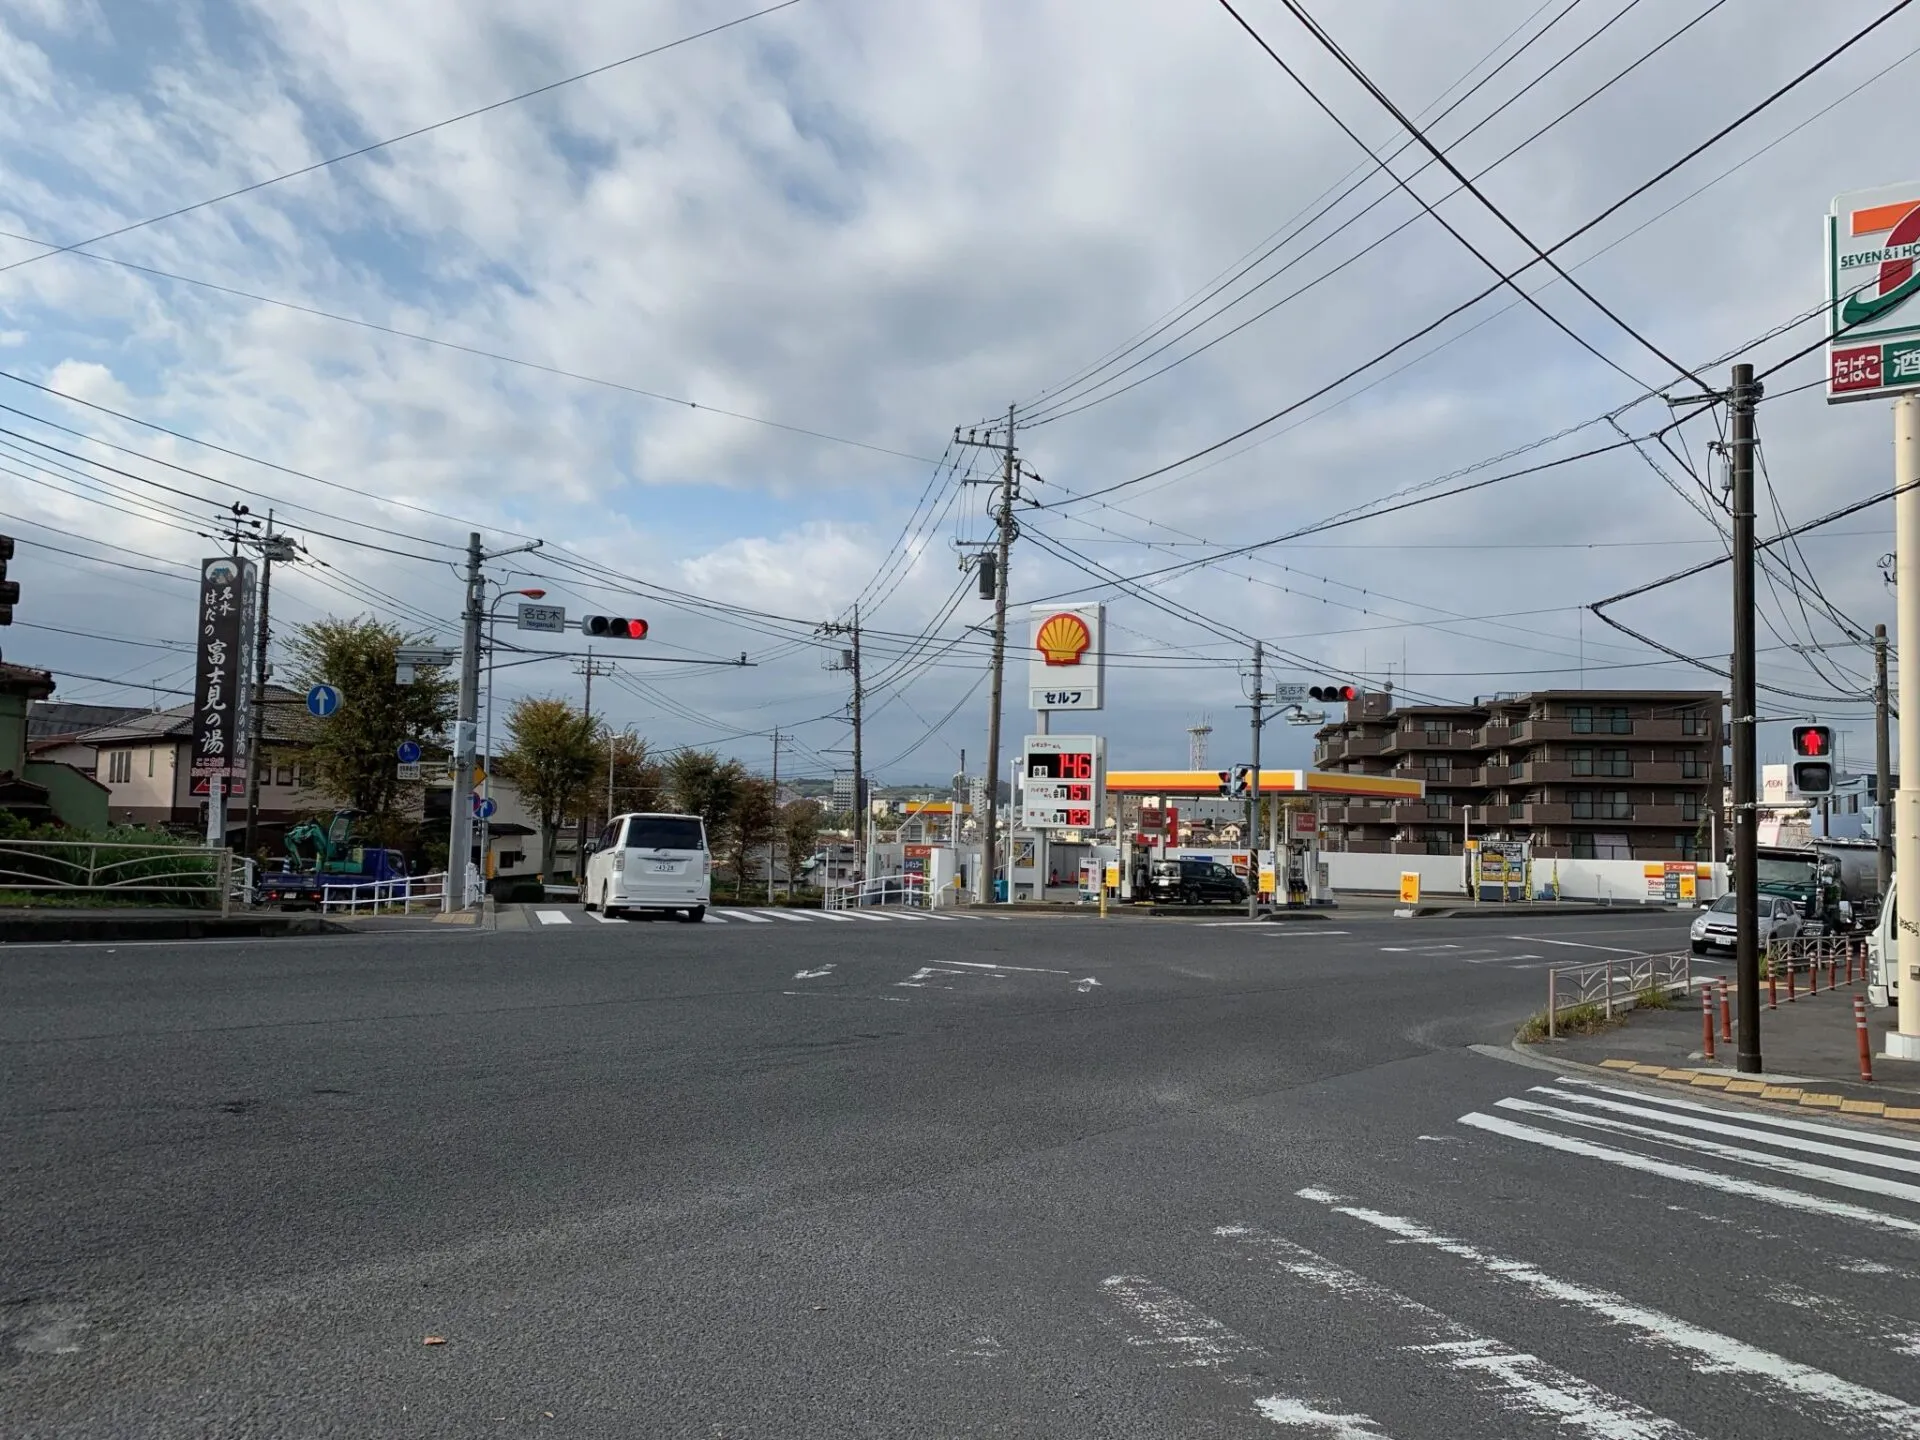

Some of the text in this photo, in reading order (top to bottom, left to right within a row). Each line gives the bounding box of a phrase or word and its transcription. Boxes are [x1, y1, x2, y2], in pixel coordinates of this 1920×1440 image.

[1893, 343, 1920, 377] 酒
[1834, 354, 1880, 384] たばこ
[220, 586, 237, 617] 名水
[523, 607, 560, 620] 名古木
[1044, 691, 1082, 704] セルフ
[1279, 686, 1306, 695] 名古木
[1034, 767, 1047, 777] 会員
[1059, 753, 1090, 779] 146
[1053, 785, 1090, 801] 会員 157
[1052, 809, 1089, 825] 会員 123
